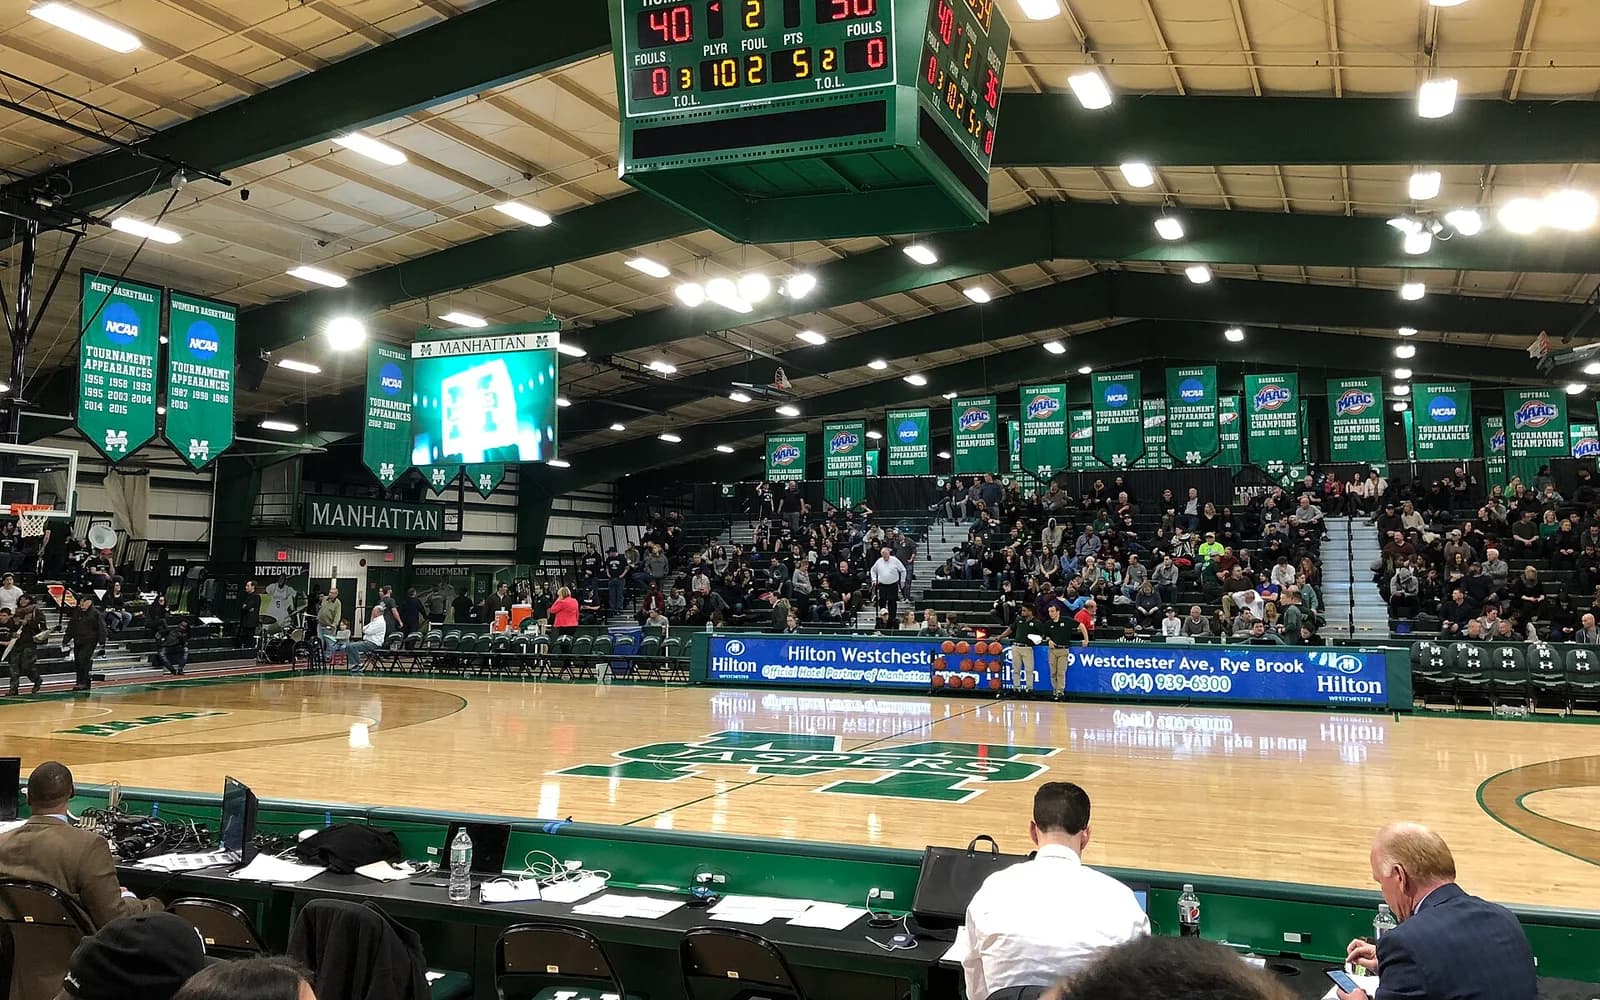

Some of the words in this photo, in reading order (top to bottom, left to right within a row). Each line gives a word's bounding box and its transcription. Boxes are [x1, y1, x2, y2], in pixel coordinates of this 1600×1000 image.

[745, 0, 761, 28] 2
[650, 6, 691, 43] 40
[847, 21, 883, 37] FOULS
[938, 1, 953, 46] 40
[741, 37, 768, 51] FOUL
[783, 32, 803, 46] PTS
[703, 43, 728, 56] PLYR
[867, 38, 884, 69] 0
[963, 43, 973, 70] 2
[635, 51, 666, 66] FOULS
[792, 50, 809, 77] 5
[821, 49, 835, 70] 2
[713, 59, 736, 88] 10
[747, 56, 762, 84] 2
[928, 55, 937, 84] 0
[652, 68, 668, 97] 0
[680, 69, 691, 90] 3
[815, 76, 845, 90] T.O.L.
[937, 70, 944, 91] 3
[673, 96, 700, 108] T.O.L.
[947, 81, 957, 110] 10
[957, 93, 965, 119] 2
[968, 108, 976, 134] 5
[975, 120, 982, 138] 2
[984, 130, 993, 155] 0
[91, 281, 112, 294] MEN'S
[112, 286, 154, 303] BASKETBALL
[171, 300, 200, 316] WOMEN'S
[200, 305, 236, 321] BASKETBALL
[105, 320, 138, 337] NCAA
[188, 337, 218, 353] NCAA
[438, 336, 526, 355] MANHATTAN
[85, 345, 153, 367] TOURNAMENT
[378, 348, 406, 361] VOLLEYBALL
[83, 358, 153, 379] APPEARANCES
[171, 361, 230, 380] TOURNAMENT
[132, 380, 152, 392] 1993
[171, 373, 230, 391] APPEARANCES
[380, 377, 402, 389] NCAA
[1340, 380, 1368, 388] BASEBALL
[84, 387, 104, 399] 1995
[107, 390, 128, 402] 2003
[131, 393, 152, 405] 2004
[171, 387, 188, 398] 1987
[1107, 394, 1128, 402] NCAA
[1181, 390, 1204, 398] NCAA
[1254, 388, 1291, 410] MAAC
[84, 400, 104, 412] 2014
[108, 403, 128, 415] 2015
[171, 399, 188, 410] 2003
[369, 397, 412, 413] TOURNAMENT
[1027, 398, 1058, 418] MAAC
[1337, 393, 1373, 414] MAAC
[368, 409, 412, 422] APPEARANCES
[960, 410, 990, 430] MAAC
[1096, 409, 1139, 418] TOURNAMENT
[1096, 416, 1139, 425] APPEARANCES
[1170, 412, 1215, 421] APPEARANCES
[1250, 412, 1297, 421] TOURNAMENT
[1431, 408, 1457, 417] NCAA
[1515, 405, 1556, 425] MAAC
[1024, 421, 1065, 429] TOURNAMENT
[1251, 419, 1297, 429] CHAMPIONS
[1333, 425, 1380, 434] CHAMPIONS
[1418, 425, 1470, 433] TOURNAMENT
[899, 430, 918, 439] NCAA
[1024, 428, 1064, 437] CHAMPIONS
[1418, 432, 1470, 441] APPEARANCES
[1510, 431, 1564, 440] TOURNAMENT
[830, 434, 858, 451] MAAC
[956, 439, 995, 448] CHAMPIONS
[1511, 439, 1564, 448] CHAMPIONS
[772, 447, 800, 464] MAAC
[827, 455, 863, 463] TOURNAMENT
[890, 451, 928, 459] APPEARANCES
[827, 462, 863, 470] CHAMPIONS
[311, 502, 439, 532] MANHATTAN
[254, 565, 303, 576] INTEGRITY
[415, 567, 470, 577] COMMITMENT
[788, 646, 836, 662] Hilton
[712, 657, 757, 672] Hilton
[1080, 653, 1175, 670] Westchester
[1179, 657, 1215, 673] Ave,
[1220, 658, 1250, 674] Rye
[1255, 658, 1304, 673] Brook
[762, 664, 798, 680] Official
[798, 666, 825, 679] Hotel
[825, 667, 863, 681] Partner
[864, 668, 878, 682] of
[877, 669, 931, 683] Manhattan
[1111, 672, 1154, 692] (914)
[1154, 674, 1232, 694] 939-6300
[1317, 674, 1382, 694] Hilton
[1328, 695, 1372, 703] WESTCHESTER
[647, 746, 1006, 776] JASPERS
